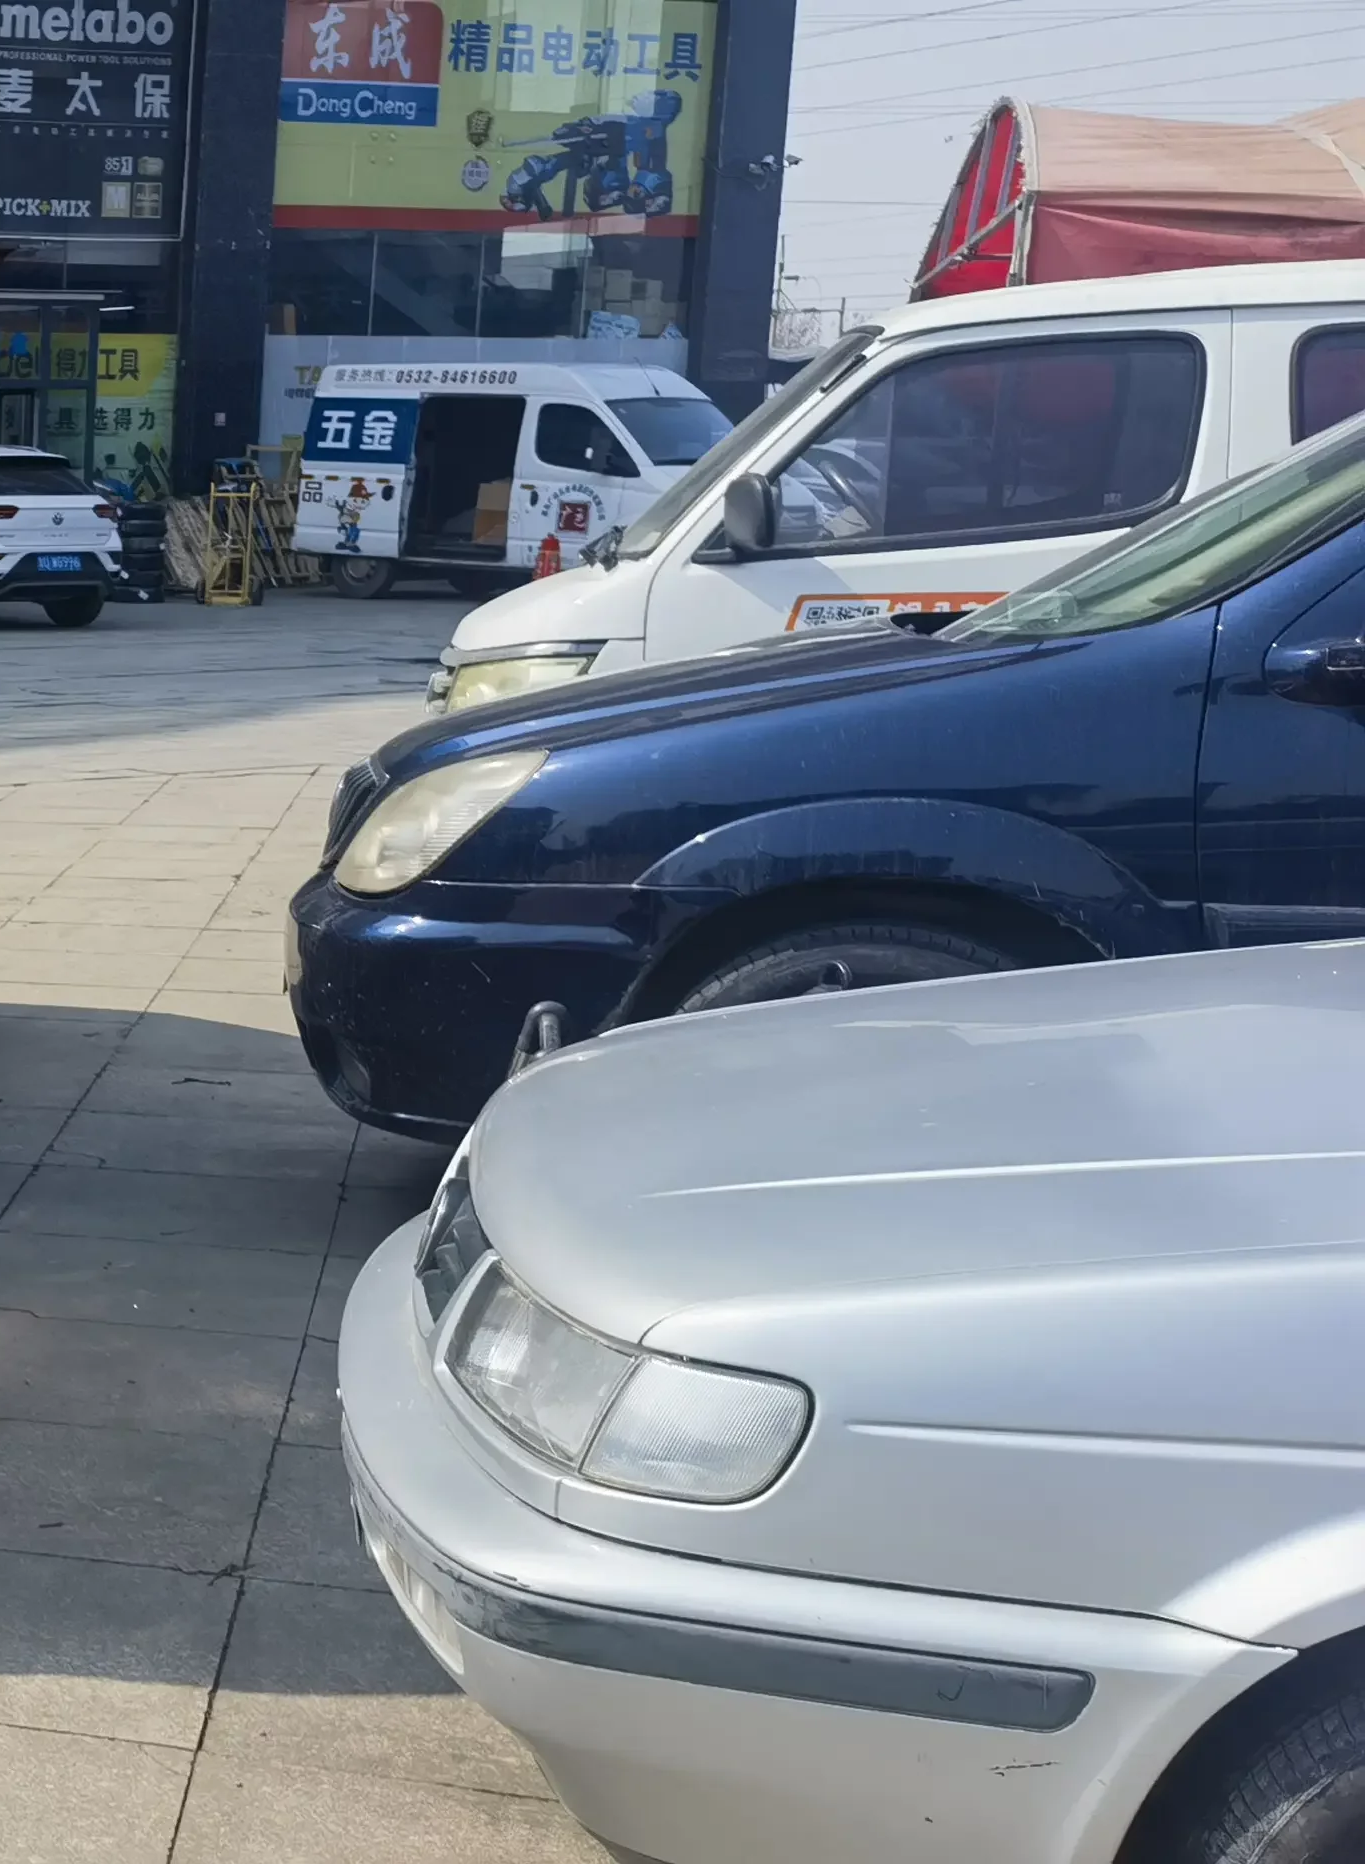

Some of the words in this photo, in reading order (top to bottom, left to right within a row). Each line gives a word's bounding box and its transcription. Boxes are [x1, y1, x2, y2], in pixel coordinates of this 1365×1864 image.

[0, 0, 174, 45] metabo
[310, 4, 412, 79] 东成
[447, 20, 702, 82] 精品电动工具
[317, 409, 398, 451] 五金
